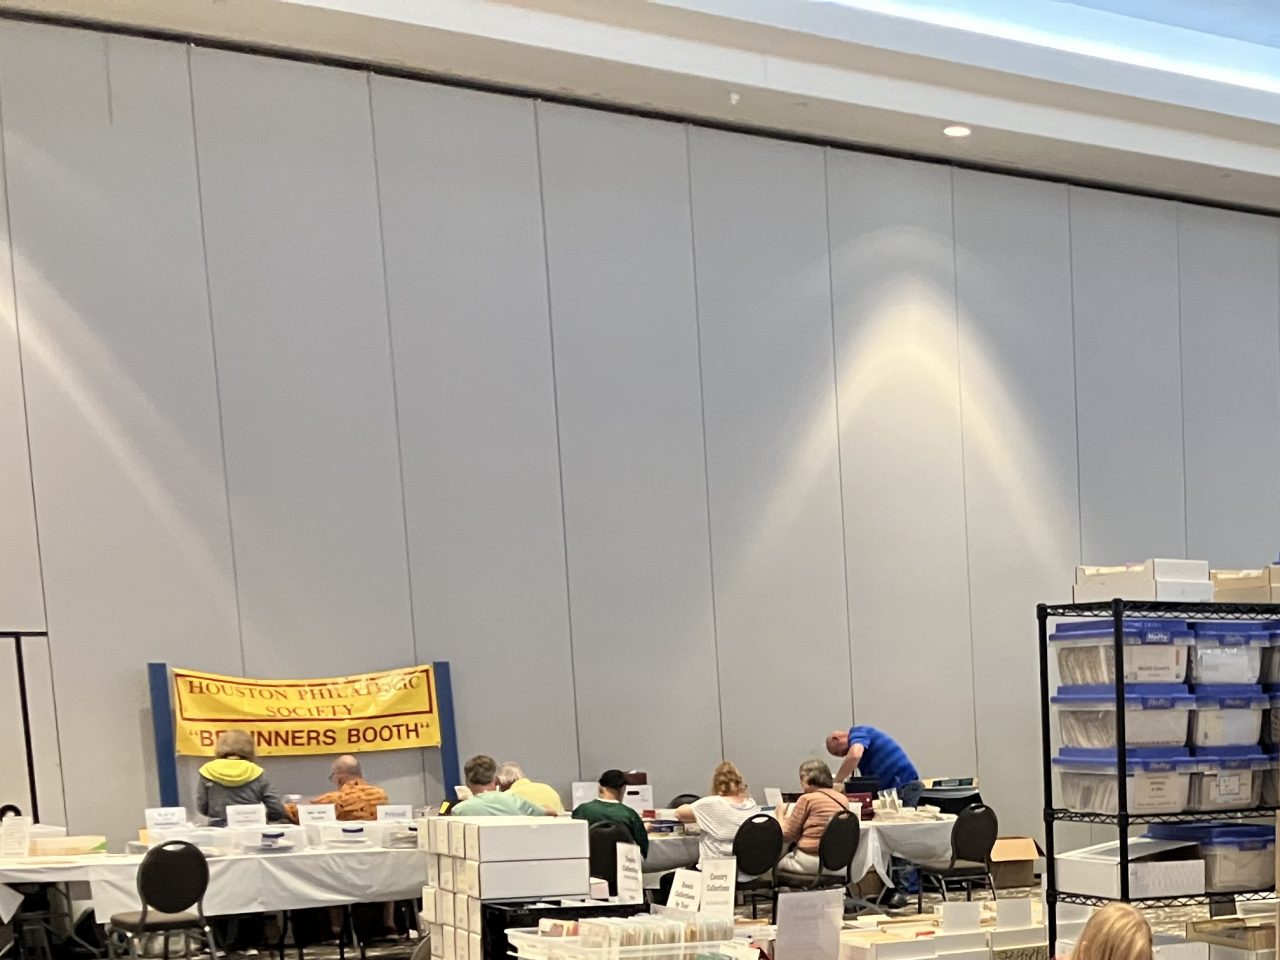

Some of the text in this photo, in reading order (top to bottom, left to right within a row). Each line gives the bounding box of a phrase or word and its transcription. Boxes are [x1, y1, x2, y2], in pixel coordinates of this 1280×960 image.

[188, 680, 288, 700] HOUSTON
[266, 704, 354, 718] SOCIETY
[189, 728, 337, 747] “BNNERS
